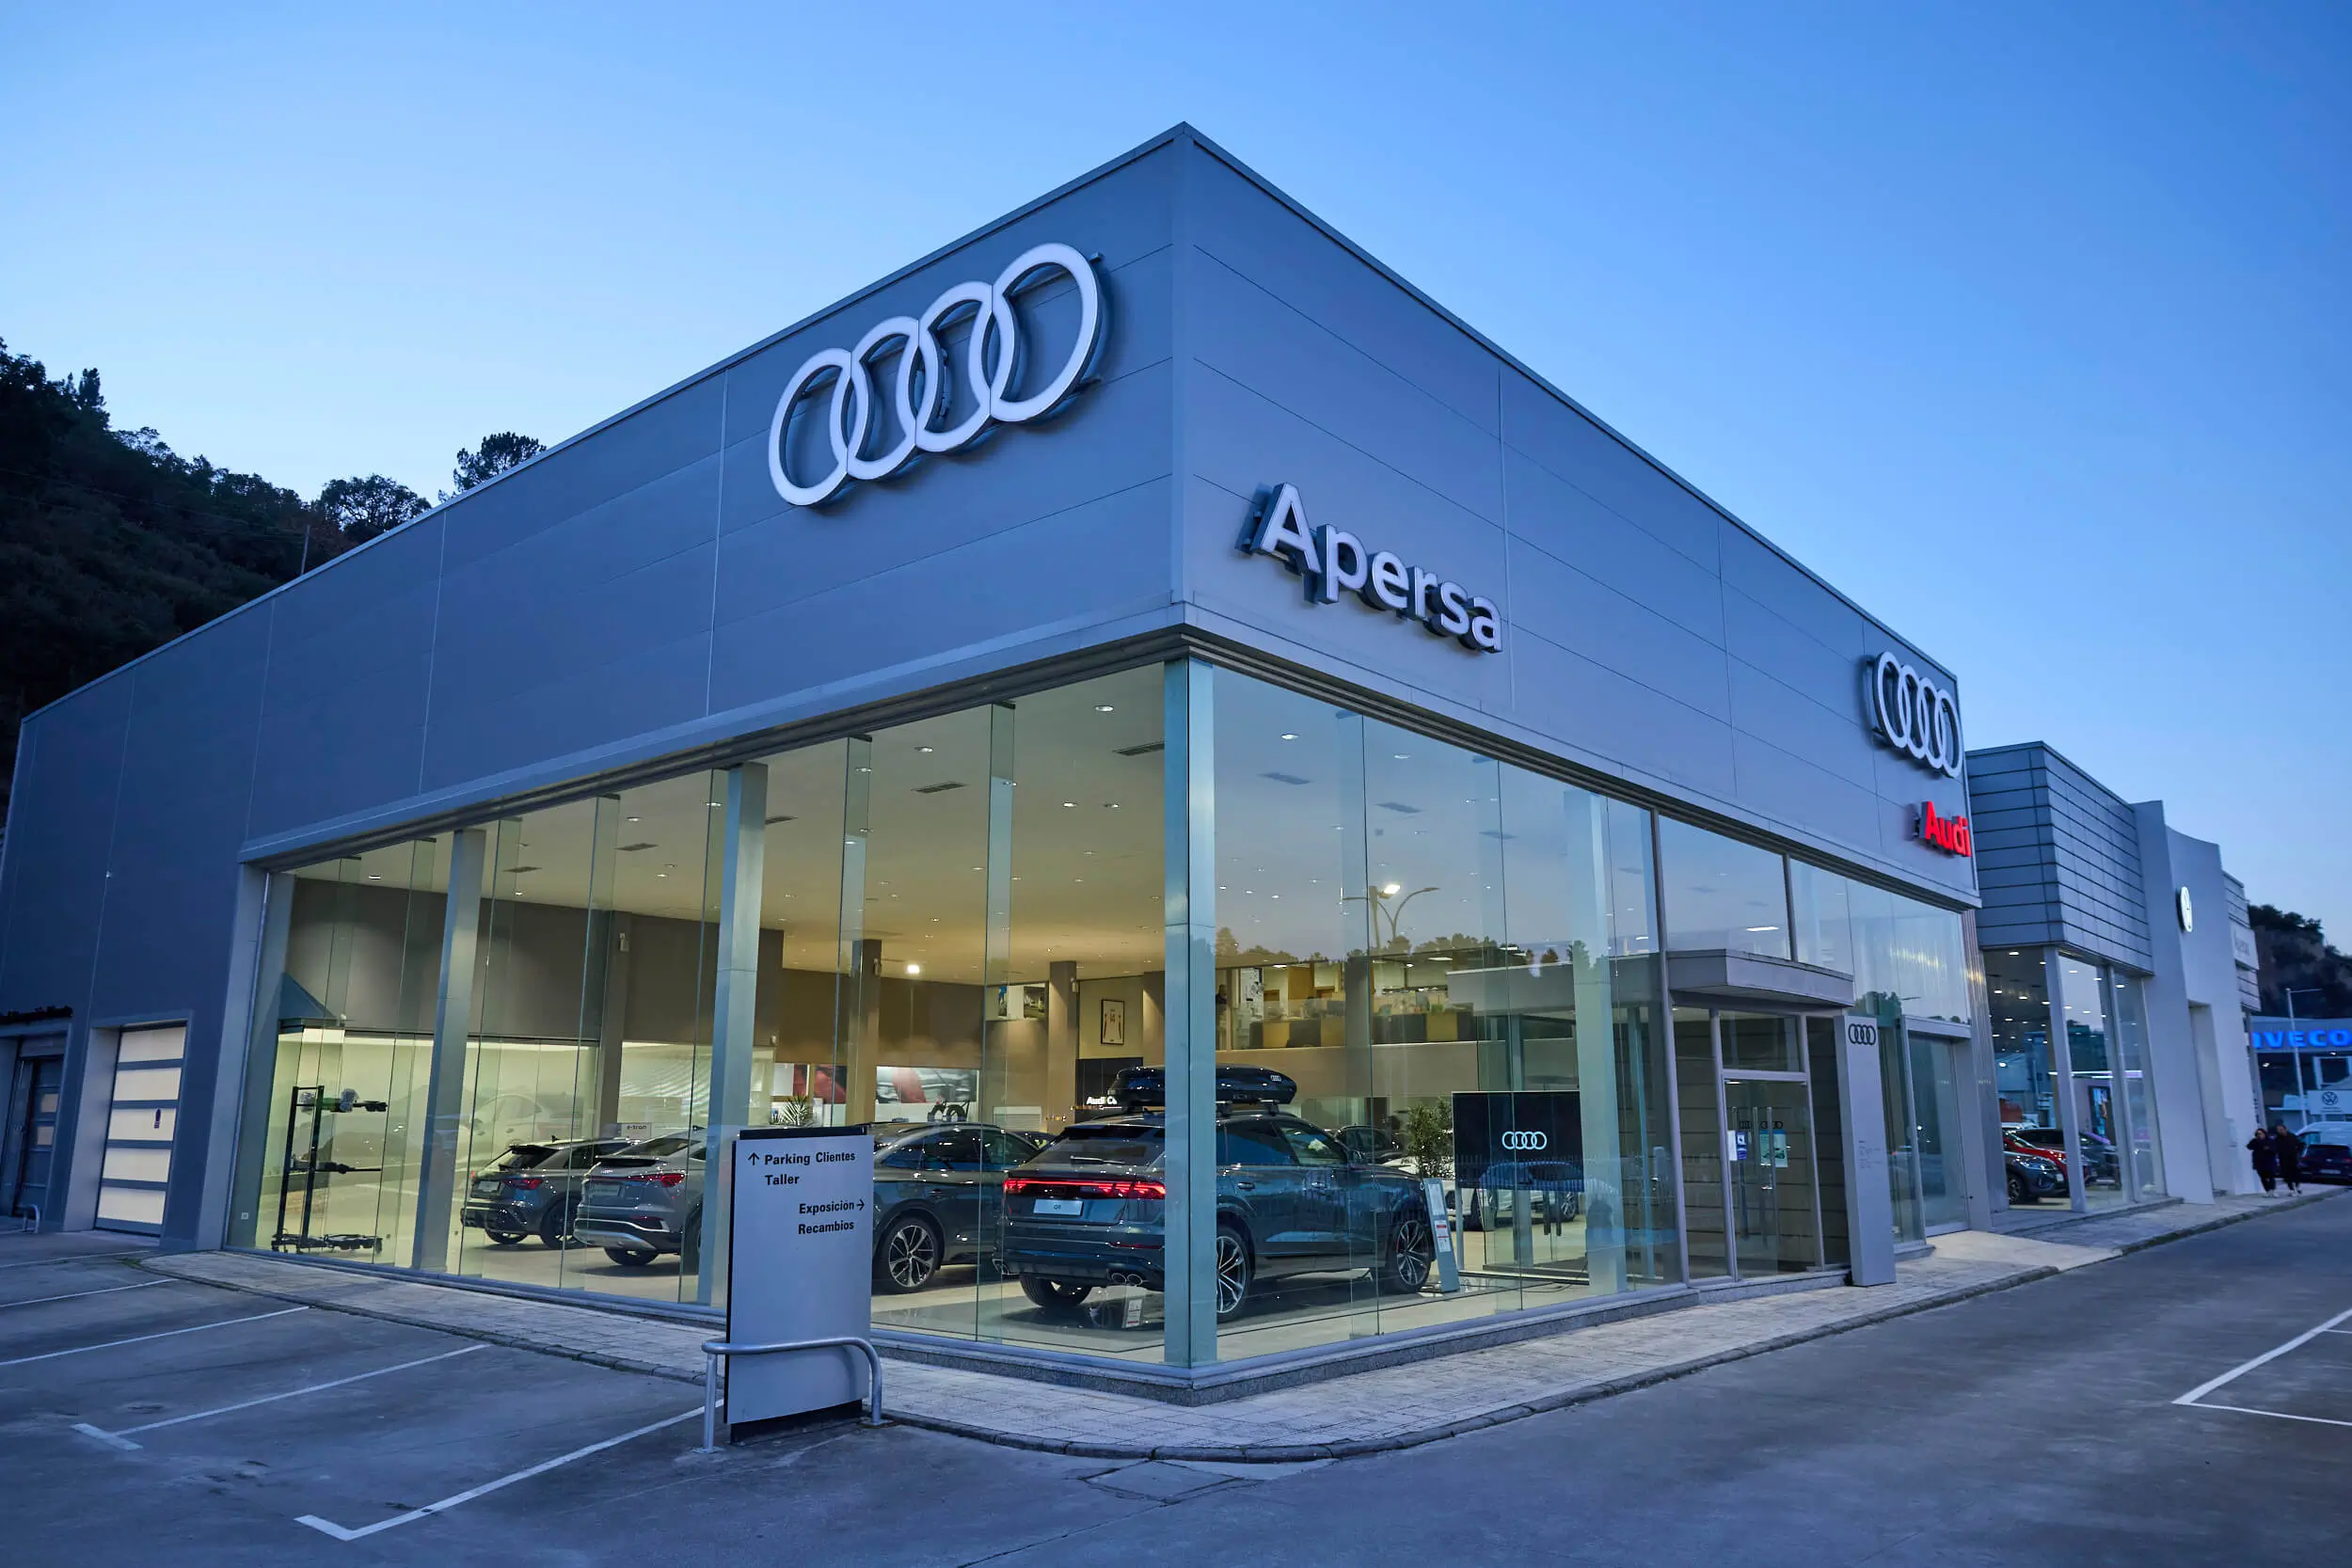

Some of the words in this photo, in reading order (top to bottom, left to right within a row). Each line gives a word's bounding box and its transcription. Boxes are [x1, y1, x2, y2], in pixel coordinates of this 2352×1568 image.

[1254, 482, 1503, 654] Apersa
[1921, 800, 1972, 857] Audi
[2251, 1029, 2351, 1049] IVECO
[1086, 1096, 1106, 1105] Audi
[764, 1153, 811, 1165] Parking
[816, 1151, 855, 1163] Clientes
[765, 1174, 800, 1185] Taller
[799, 1199, 854, 1215] Exposición
[798, 1220, 854, 1234] Recambios
